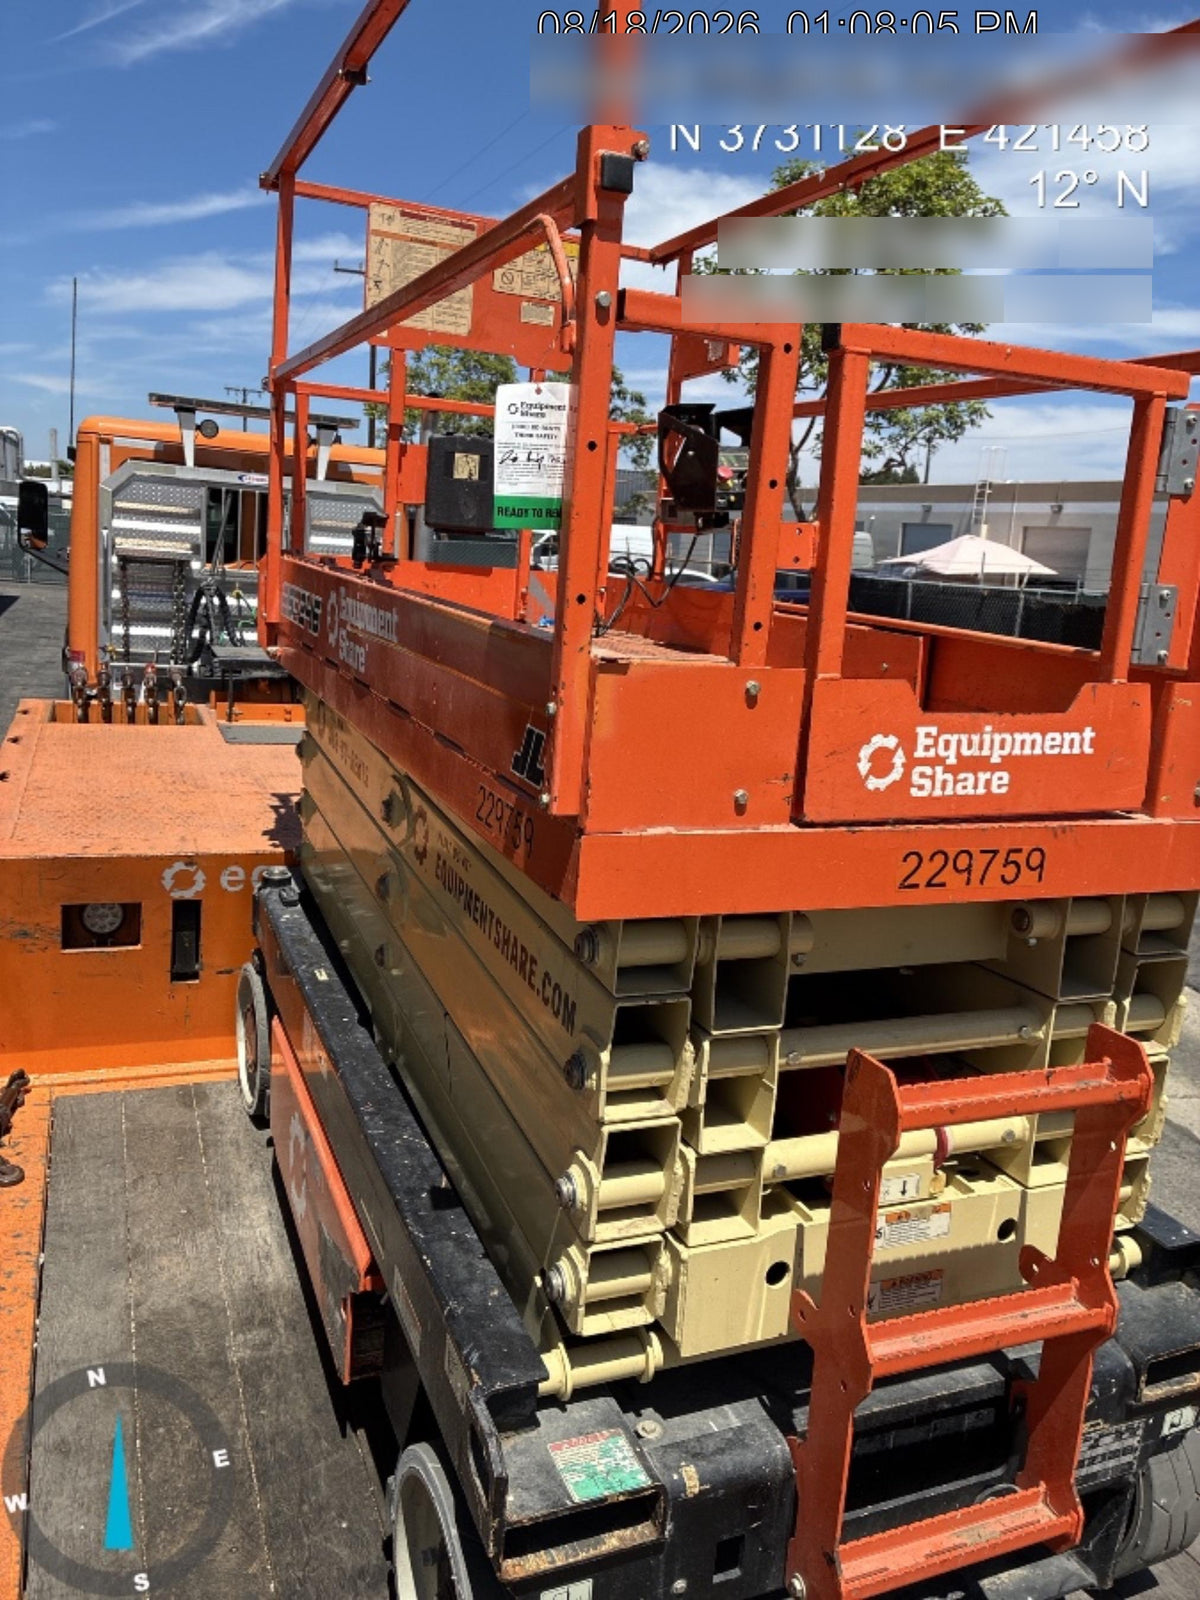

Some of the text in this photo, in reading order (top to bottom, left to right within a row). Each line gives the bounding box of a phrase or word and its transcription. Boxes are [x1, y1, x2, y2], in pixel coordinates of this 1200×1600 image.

[497, 506, 529, 518] READY
[531, 508, 543, 518] TO
[913, 725, 1096, 765] Equipment
[910, 765, 1010, 797] Share
[475, 783, 535, 858] 229759
[897, 846, 1047, 890] 229759
[435, 851, 577, 1037] EQUIPMENTSHARE.COM
